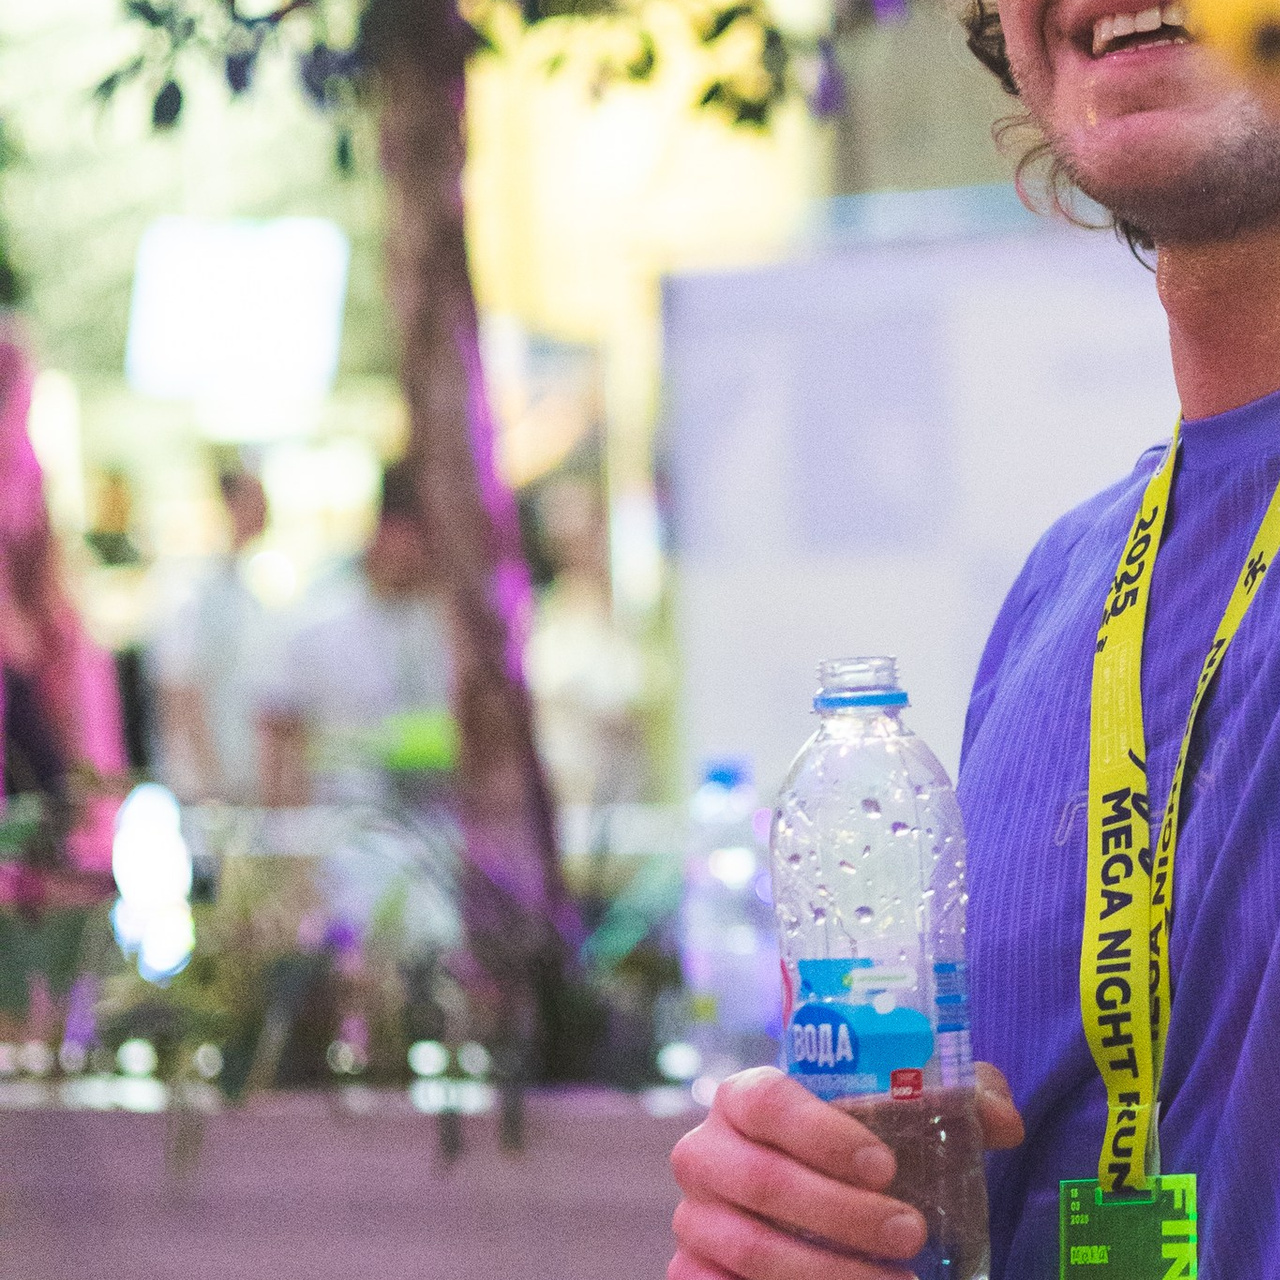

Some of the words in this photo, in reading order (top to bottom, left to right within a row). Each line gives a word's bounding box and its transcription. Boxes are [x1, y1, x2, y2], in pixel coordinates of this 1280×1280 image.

[1111, 506, 1158, 617] 2025
[1101, 787, 1134, 920] MEGA
[793, 1023, 854, 1068] ВОДА
[1096, 929, 1139, 1079] NIGHT
[1108, 1091, 1141, 1194] RUN
